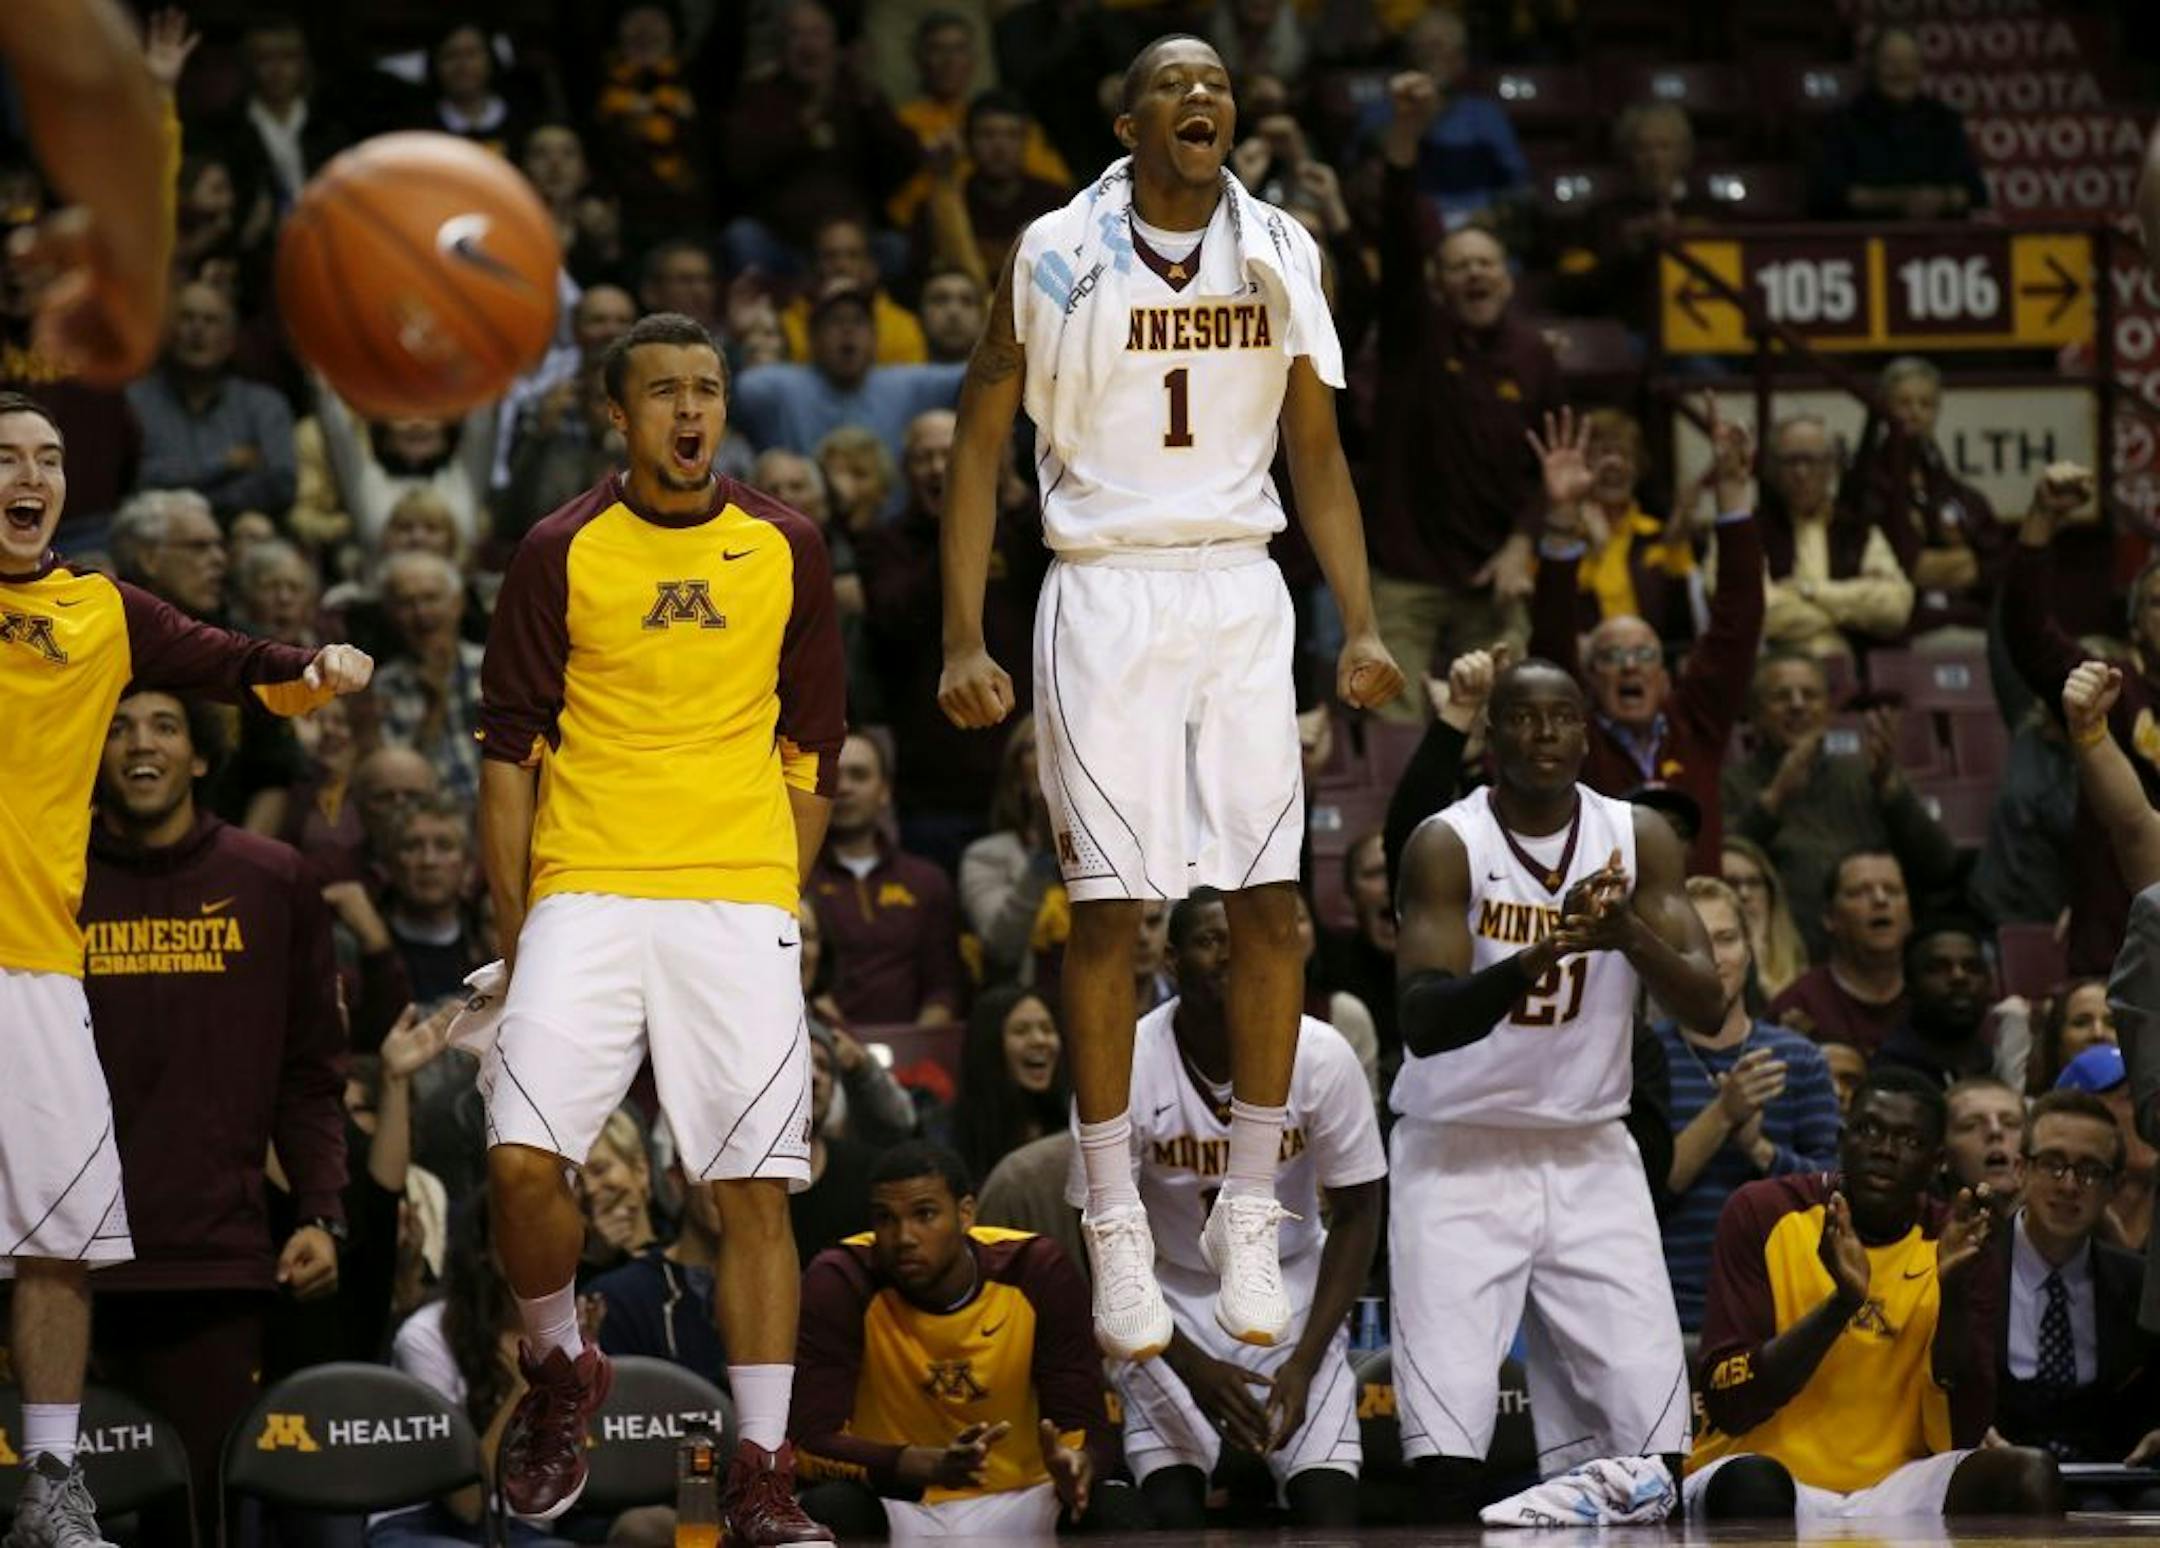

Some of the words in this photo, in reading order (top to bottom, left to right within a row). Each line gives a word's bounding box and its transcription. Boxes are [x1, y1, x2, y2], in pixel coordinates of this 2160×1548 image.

[1920, 20, 2078, 60] OYOTA
[1982, 166, 2135, 208] TOYOT
[1758, 258, 1858, 322] 105
[1899, 255, 2000, 319] 106
[1163, 366, 1194, 448] 1
[86, 916, 245, 954] MINNESOTA
[112, 951, 226, 975] BASKETBALL
[328, 1413, 450, 1446] HEALTH
